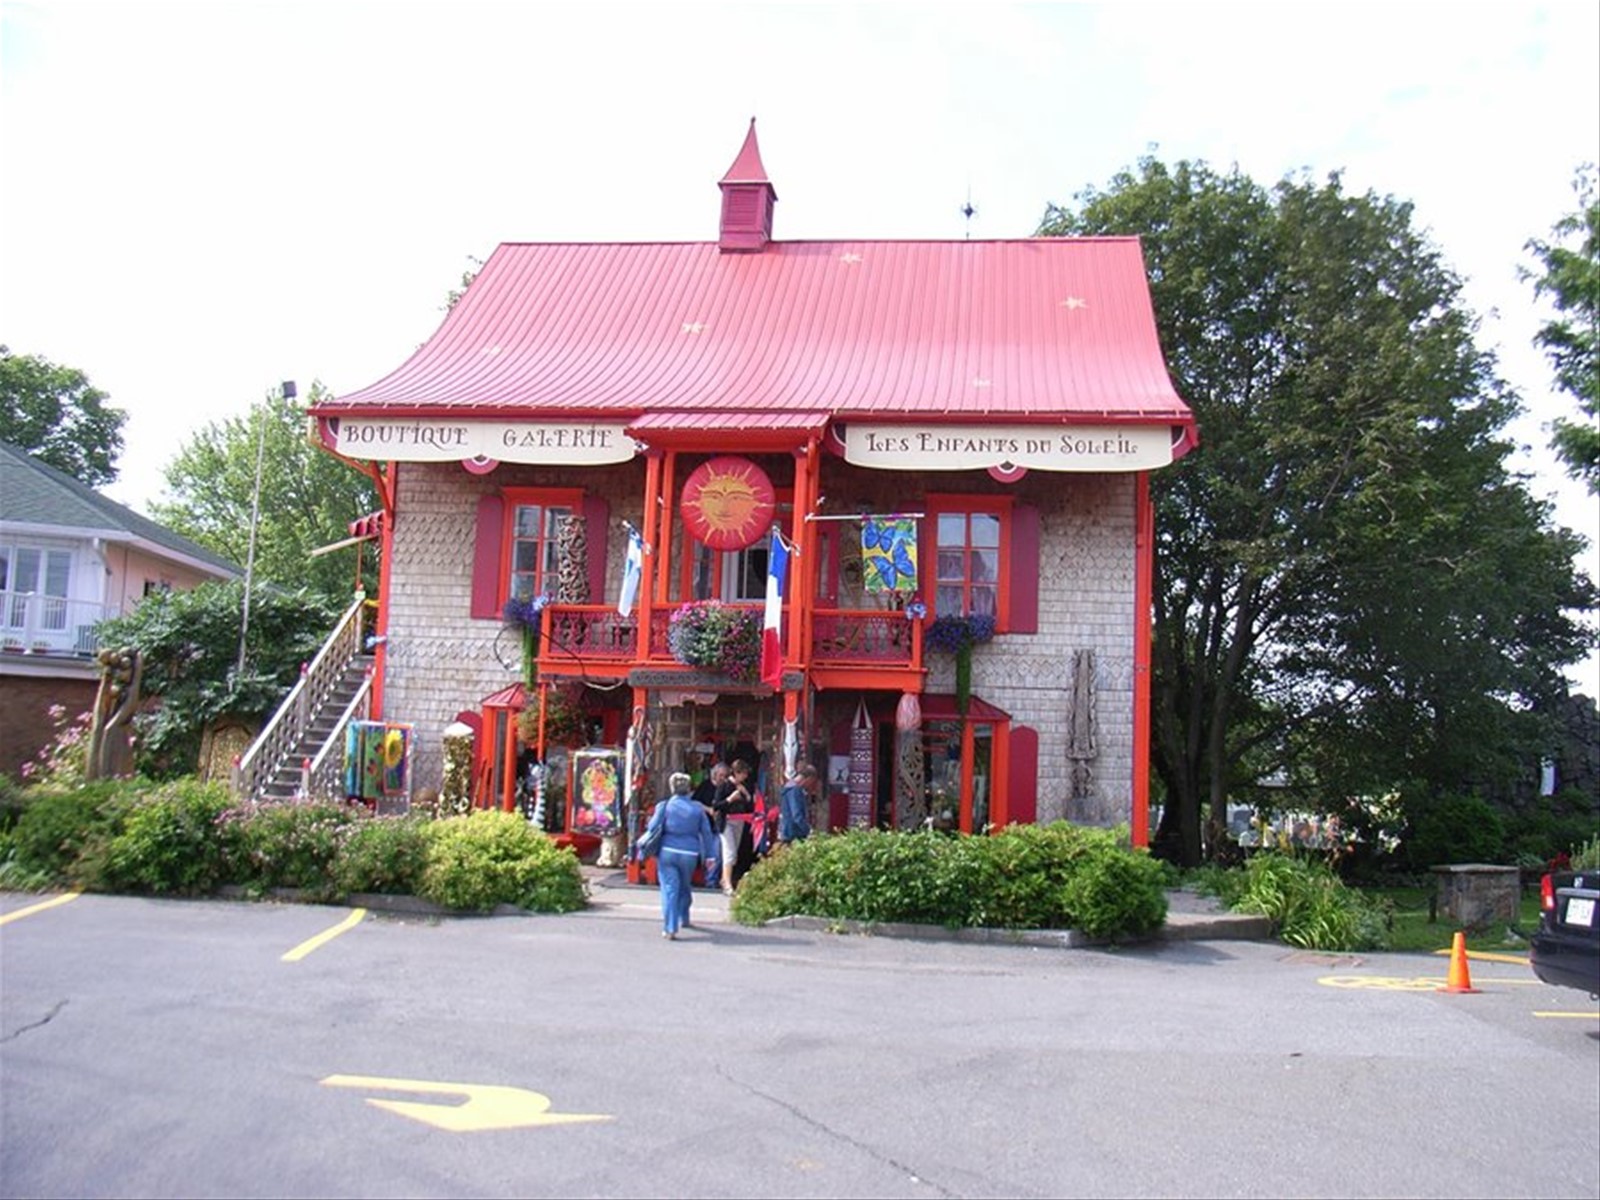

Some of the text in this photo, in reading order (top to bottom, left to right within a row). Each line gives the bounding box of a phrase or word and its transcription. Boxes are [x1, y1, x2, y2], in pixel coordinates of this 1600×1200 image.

[343, 420, 614, 452] BOUTIQUE GALERIE
[865, 431, 1139, 455] LES ENFANTS DU SOLEIL
